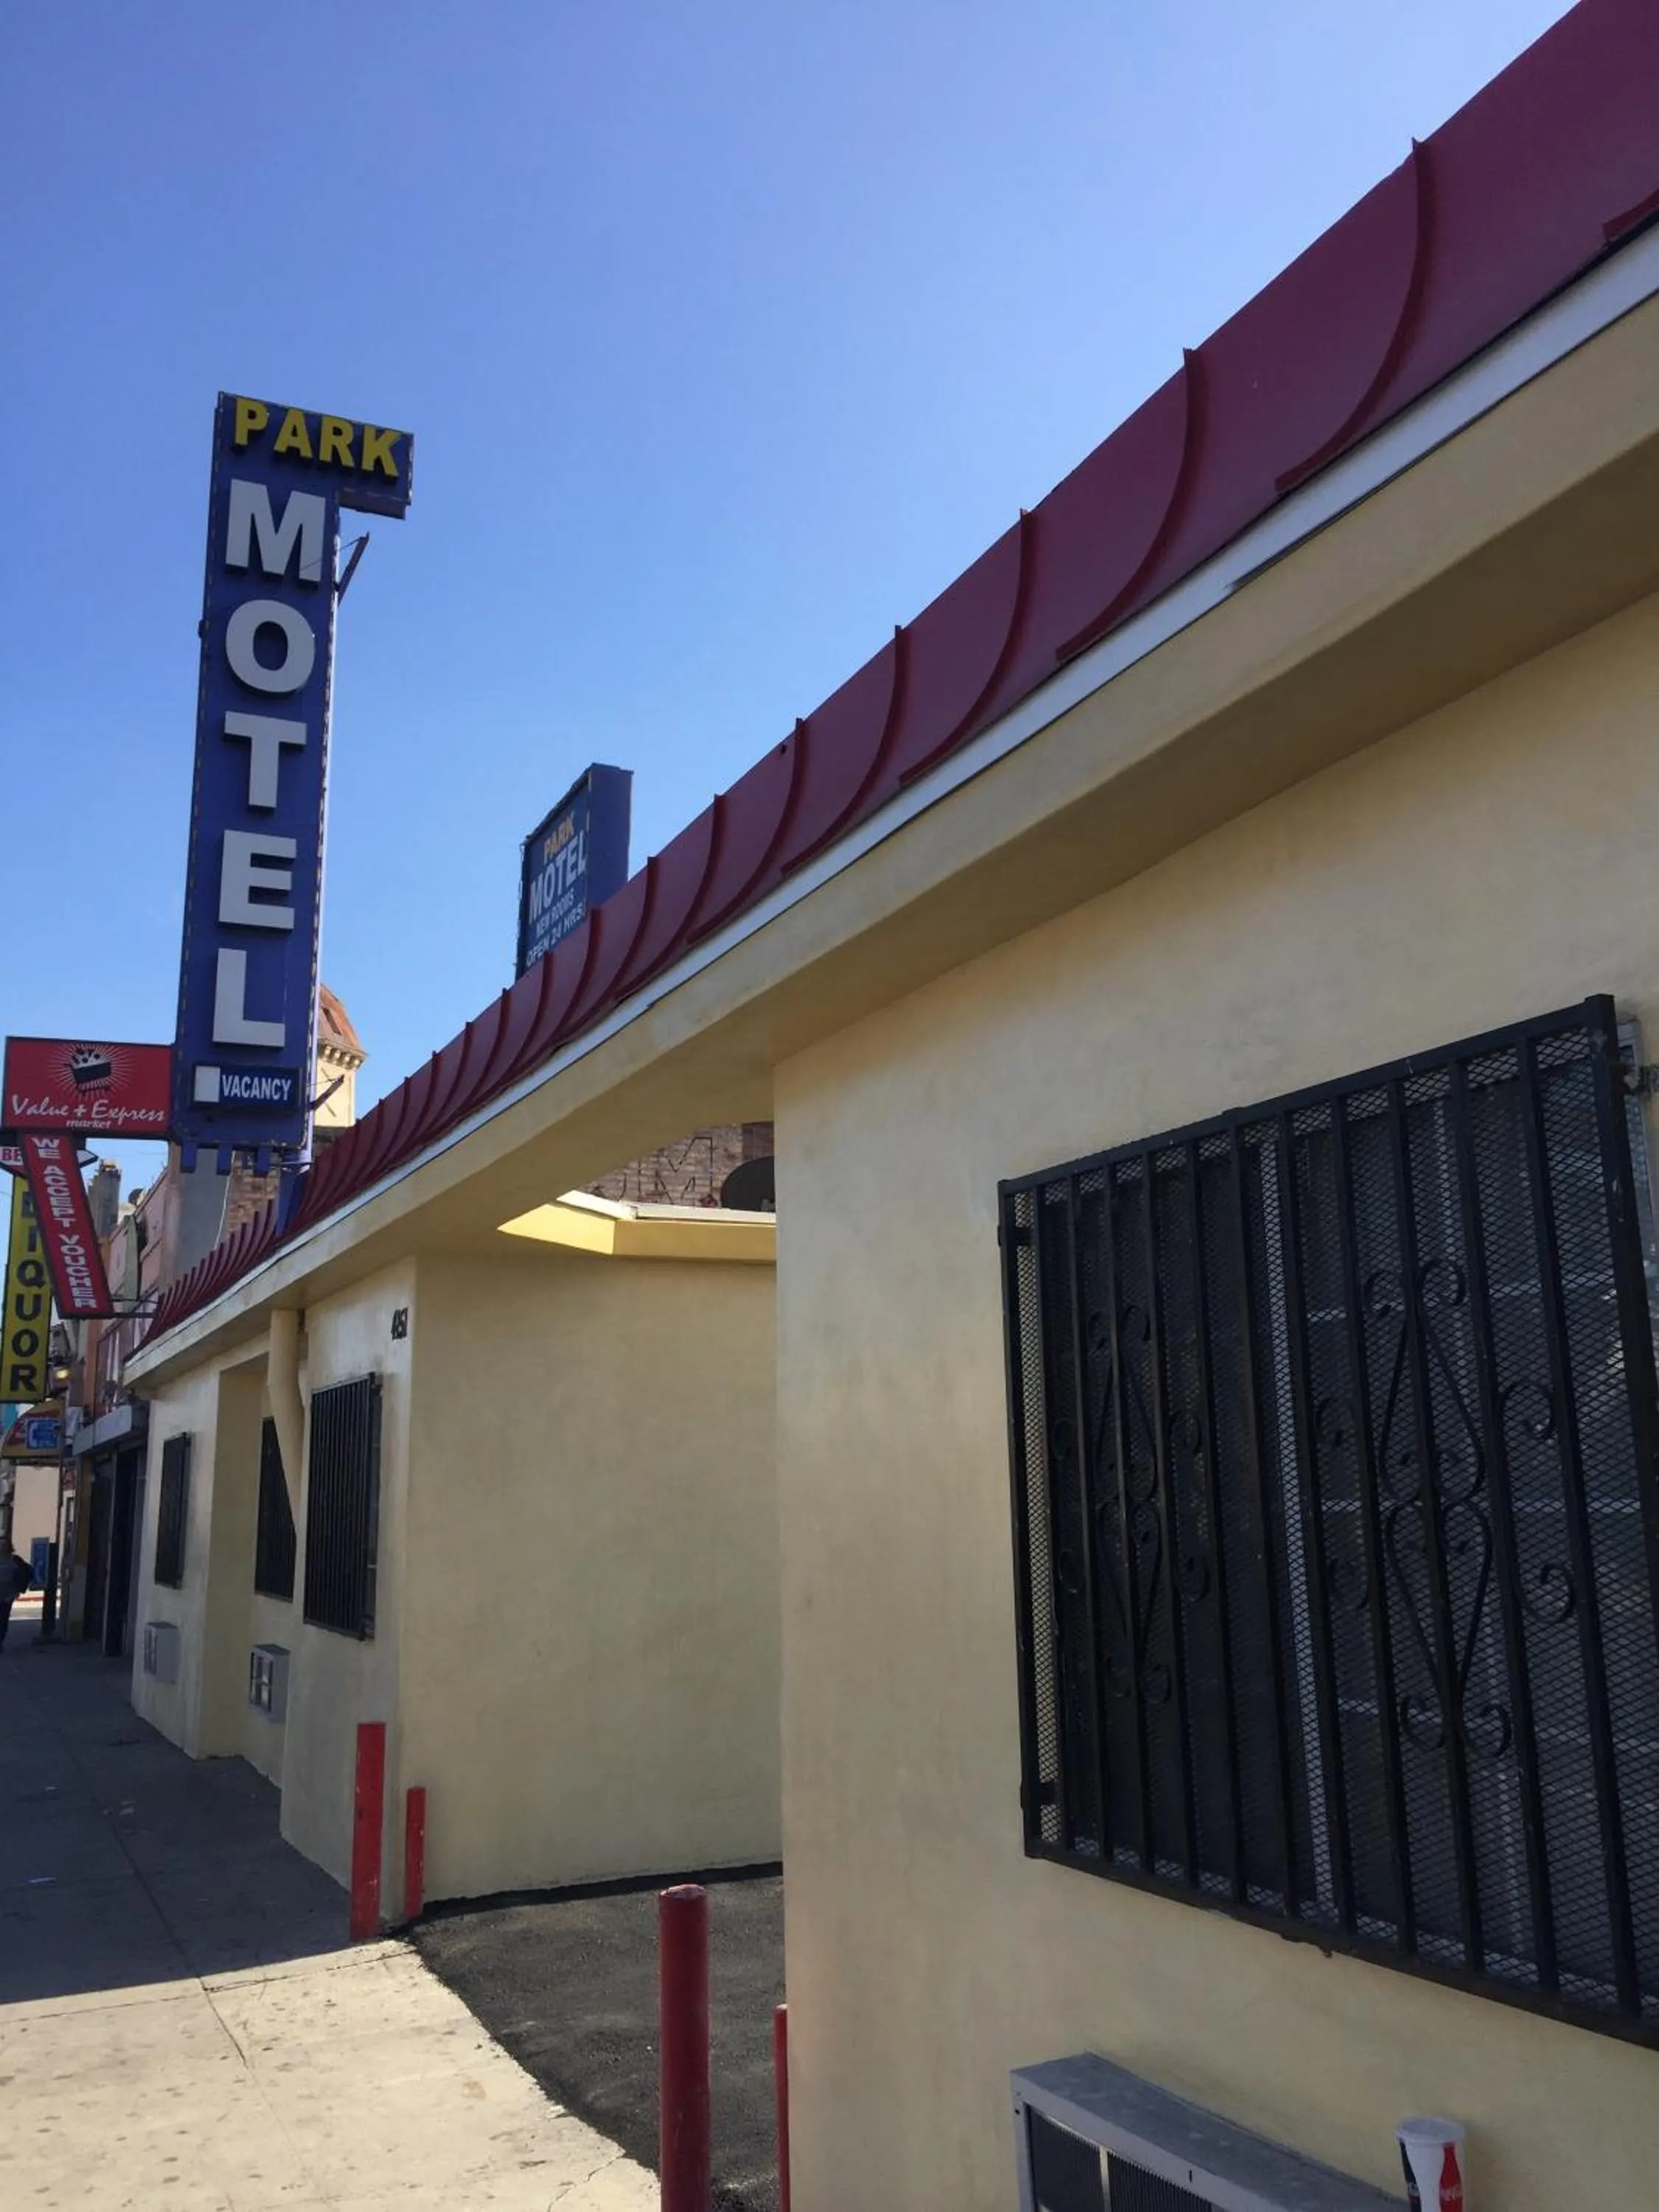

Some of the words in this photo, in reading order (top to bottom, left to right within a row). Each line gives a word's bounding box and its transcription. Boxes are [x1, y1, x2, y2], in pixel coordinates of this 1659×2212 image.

[234, 397, 402, 478] PARK
[212, 478, 326, 1048] MOTEL
[543, 810, 576, 865] PARK
[528, 829, 587, 925] MOTEL
[526, 935, 550, 967] OPEN
[12, 1093, 69, 1116] Value
[91, 1099, 166, 1126] Express
[222, 1074, 292, 1102] VACANCY
[31, 1137, 60, 1159] WE
[66, 1119, 112, 1129] market
[44, 1165, 76, 1228] ACCEPT
[59, 1234, 97, 1310] VOUCHER
